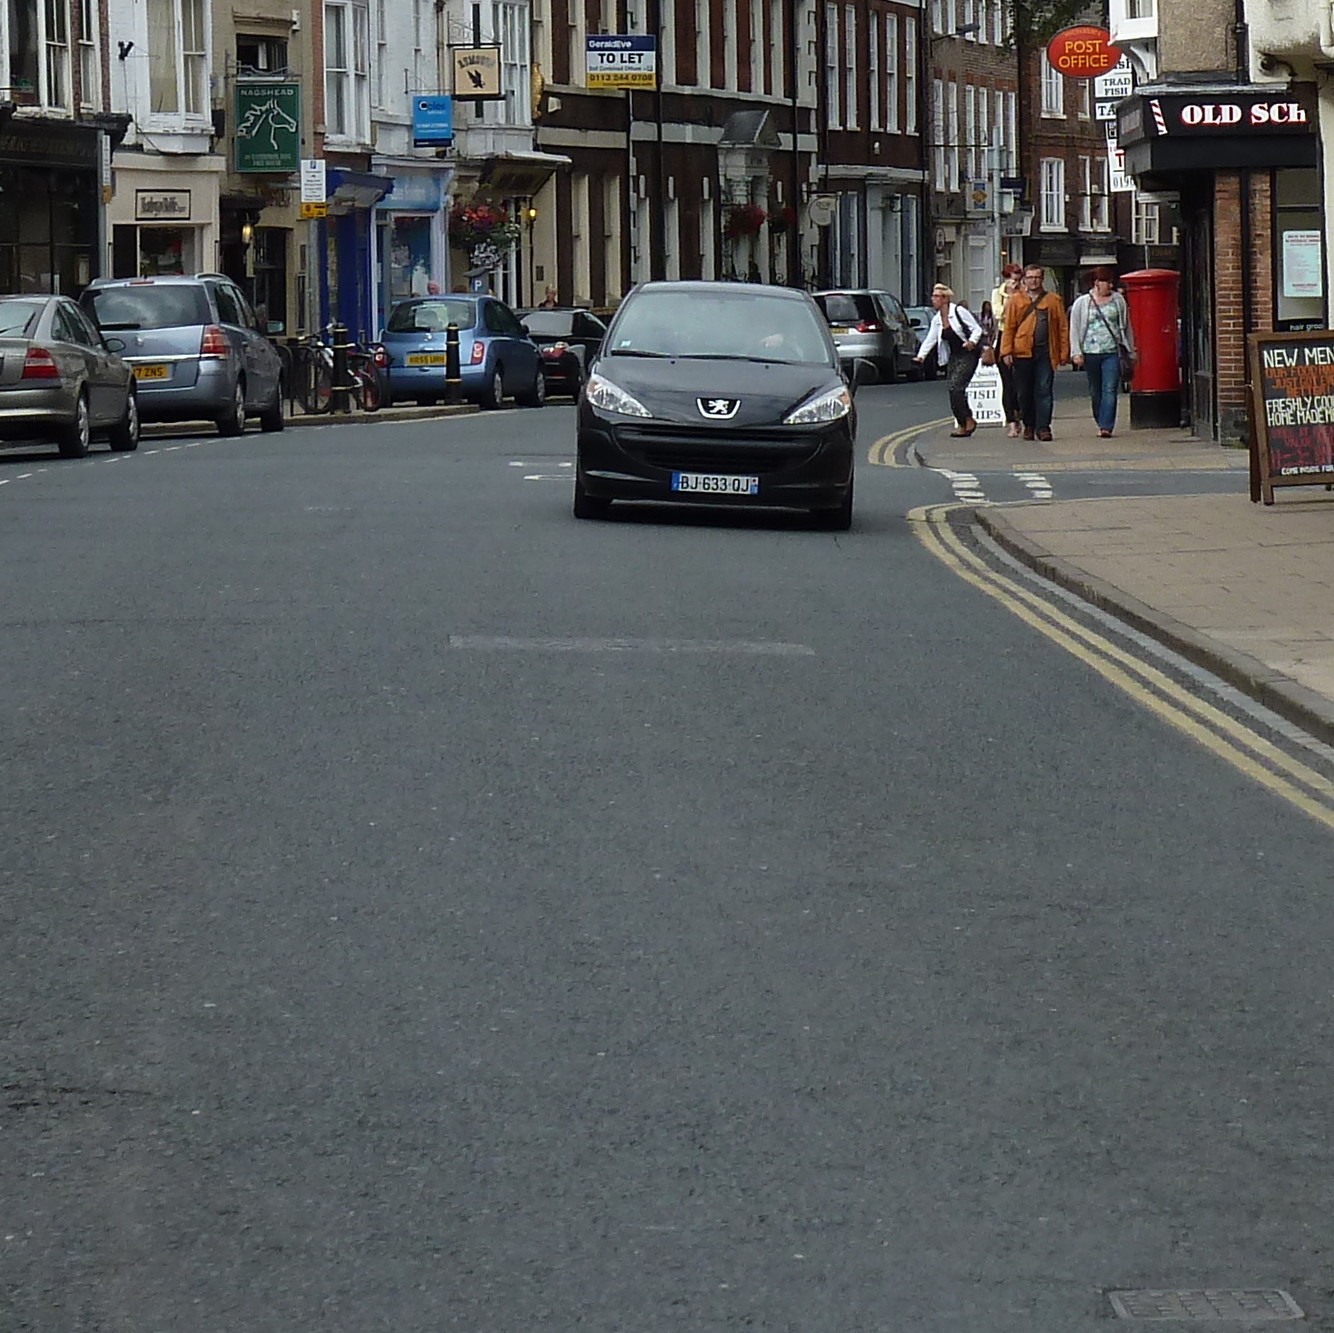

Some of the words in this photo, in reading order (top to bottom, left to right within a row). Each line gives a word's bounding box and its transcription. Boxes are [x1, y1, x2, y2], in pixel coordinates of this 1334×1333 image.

[1065, 40, 1103, 53] POST
[598, 53, 616, 64] TO
[620, 53, 644, 64] LET
[1058, 55, 1108, 68] OFFICE
[1103, 77, 1131, 86] TRAD
[1105, 87, 1128, 96] FISH
[1181, 104, 1242, 125] OLD
[475, 280, 482, 292] P
[1290, 323, 1305, 332] hair
[1263, 348, 1298, 369] NEW
[1265, 396, 1312, 413] FRESHLY
[975, 410, 1001, 419] HIPS
[1267, 410, 1296, 427] HOME
[1322, 464, 1334, 472] FOR
